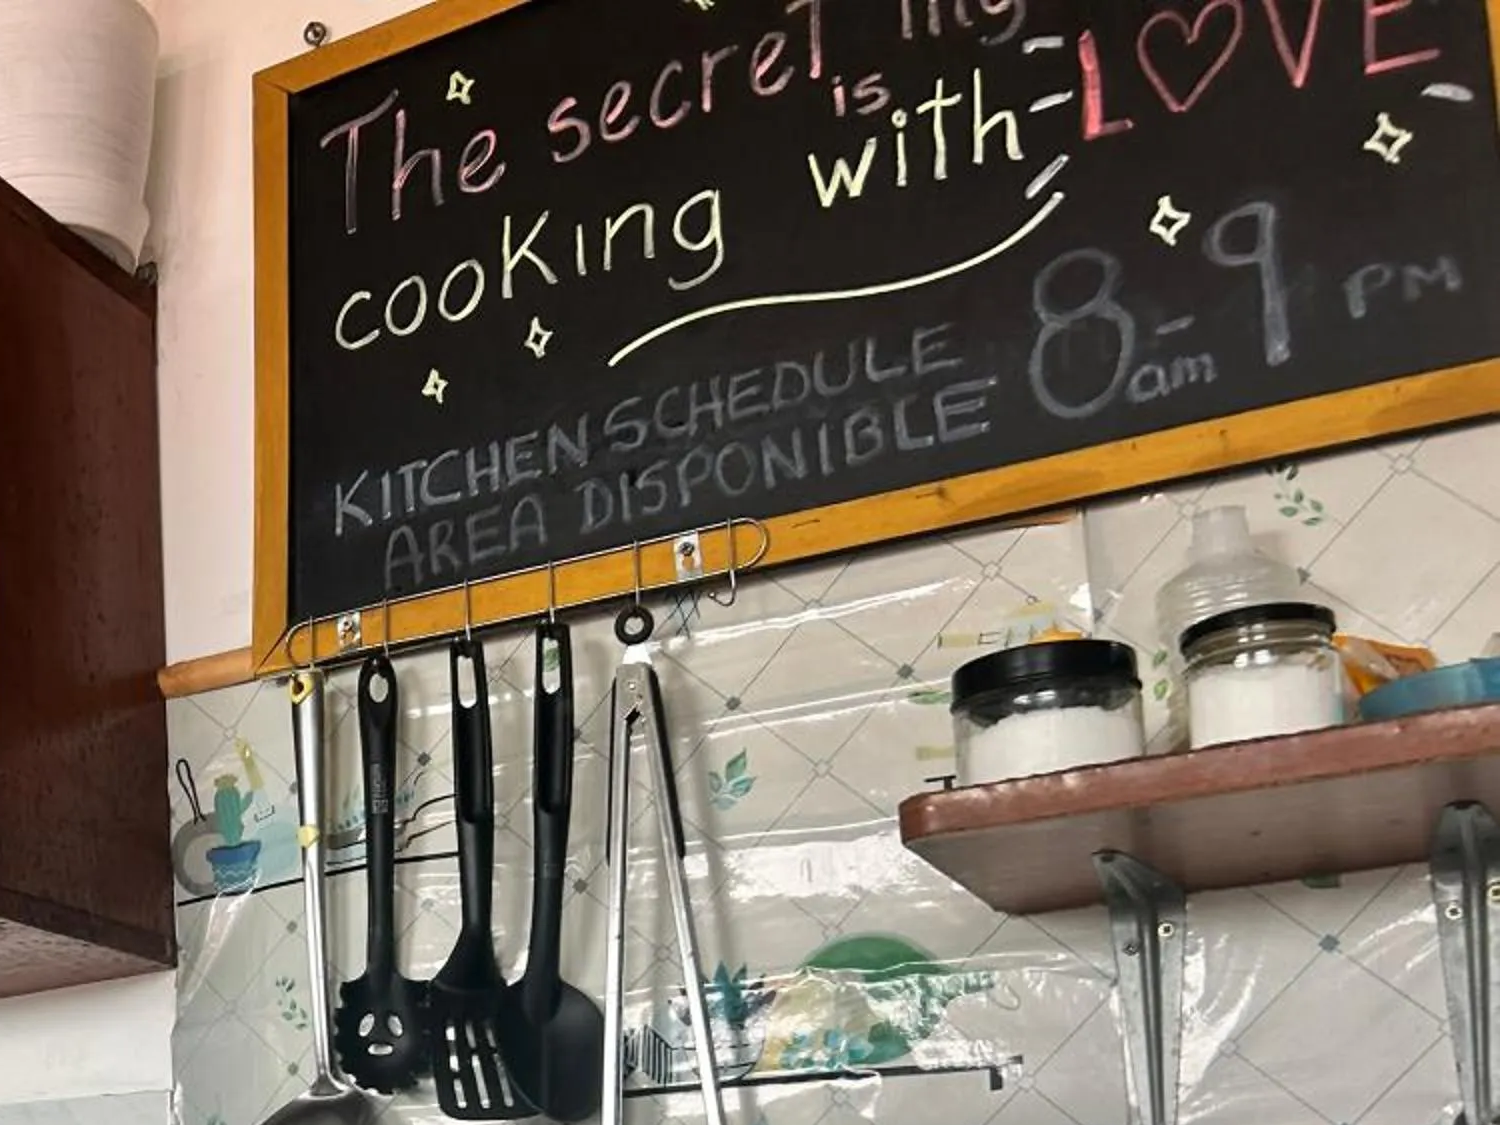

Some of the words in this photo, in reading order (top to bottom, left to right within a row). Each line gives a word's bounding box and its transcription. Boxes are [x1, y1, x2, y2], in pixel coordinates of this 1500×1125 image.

[320, 89, 506, 235] The
[808, 67, 1024, 208] with
[831, 72, 891, 117] is
[334, 409, 589, 537] KITCHEN
[603, 323, 963, 452] SCHEDULE
[383, 496, 549, 592] AREA
[579, 376, 998, 533] DISPONIBLE
